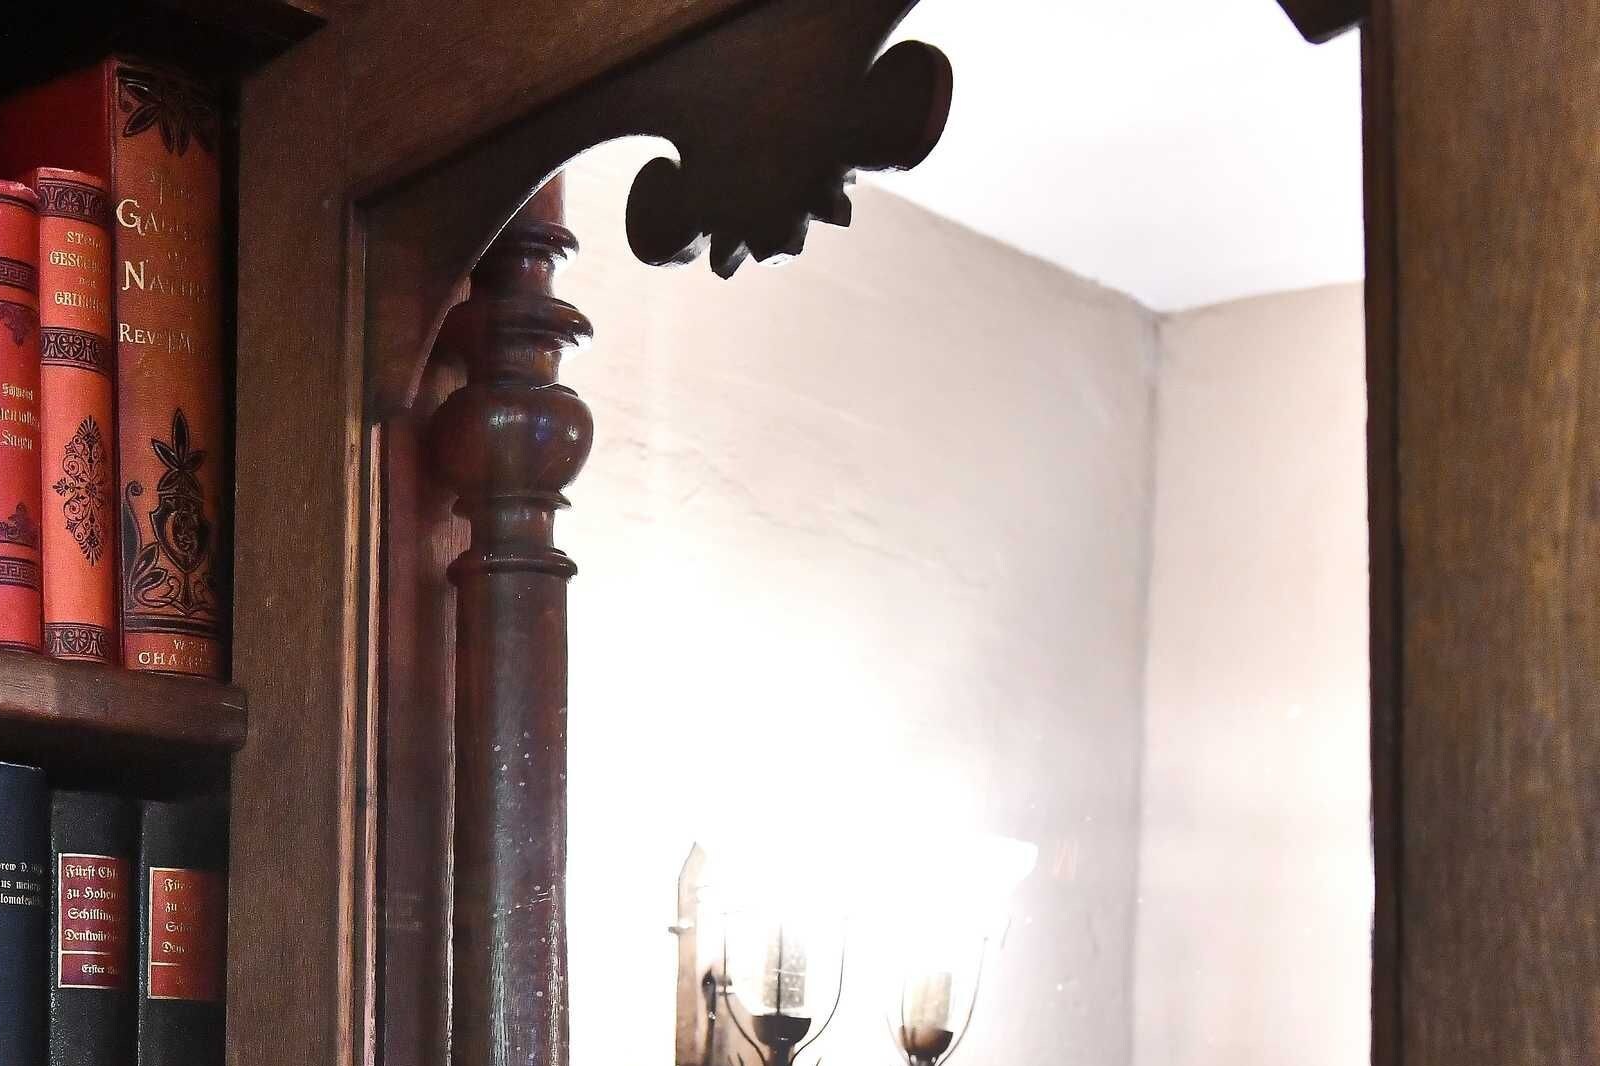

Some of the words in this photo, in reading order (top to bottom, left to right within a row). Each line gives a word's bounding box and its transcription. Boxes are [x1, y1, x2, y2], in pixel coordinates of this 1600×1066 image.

[64, 863, 96, 881] Fürst
[66, 888, 80, 900] zu
[164, 902, 177, 914] zu
